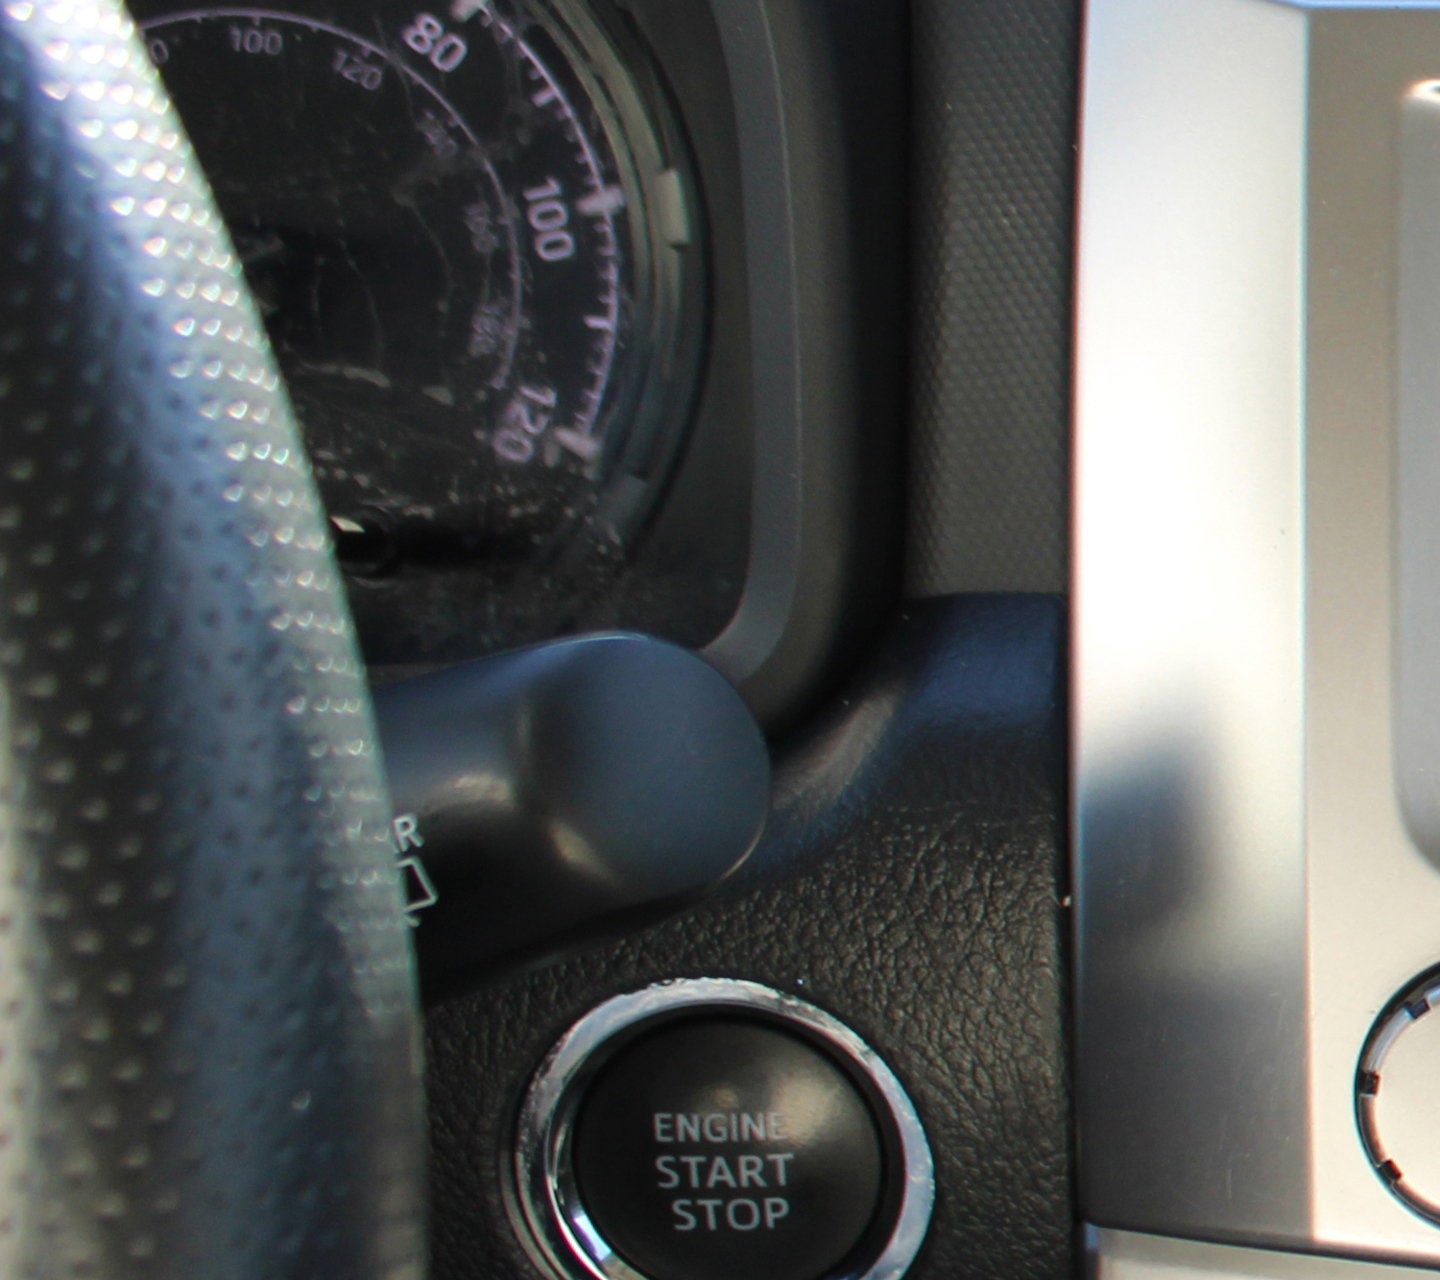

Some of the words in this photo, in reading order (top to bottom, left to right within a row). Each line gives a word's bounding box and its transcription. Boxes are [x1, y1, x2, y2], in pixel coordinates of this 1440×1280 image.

[229, 24, 283, 56] 100
[402, 13, 467, 73] 80
[523, 175, 576, 262] 100
[492, 384, 558, 463] 120
[654, 1113, 788, 1145] ENGINE
[656, 1152, 795, 1188] START
[671, 1197, 790, 1231] STOP
